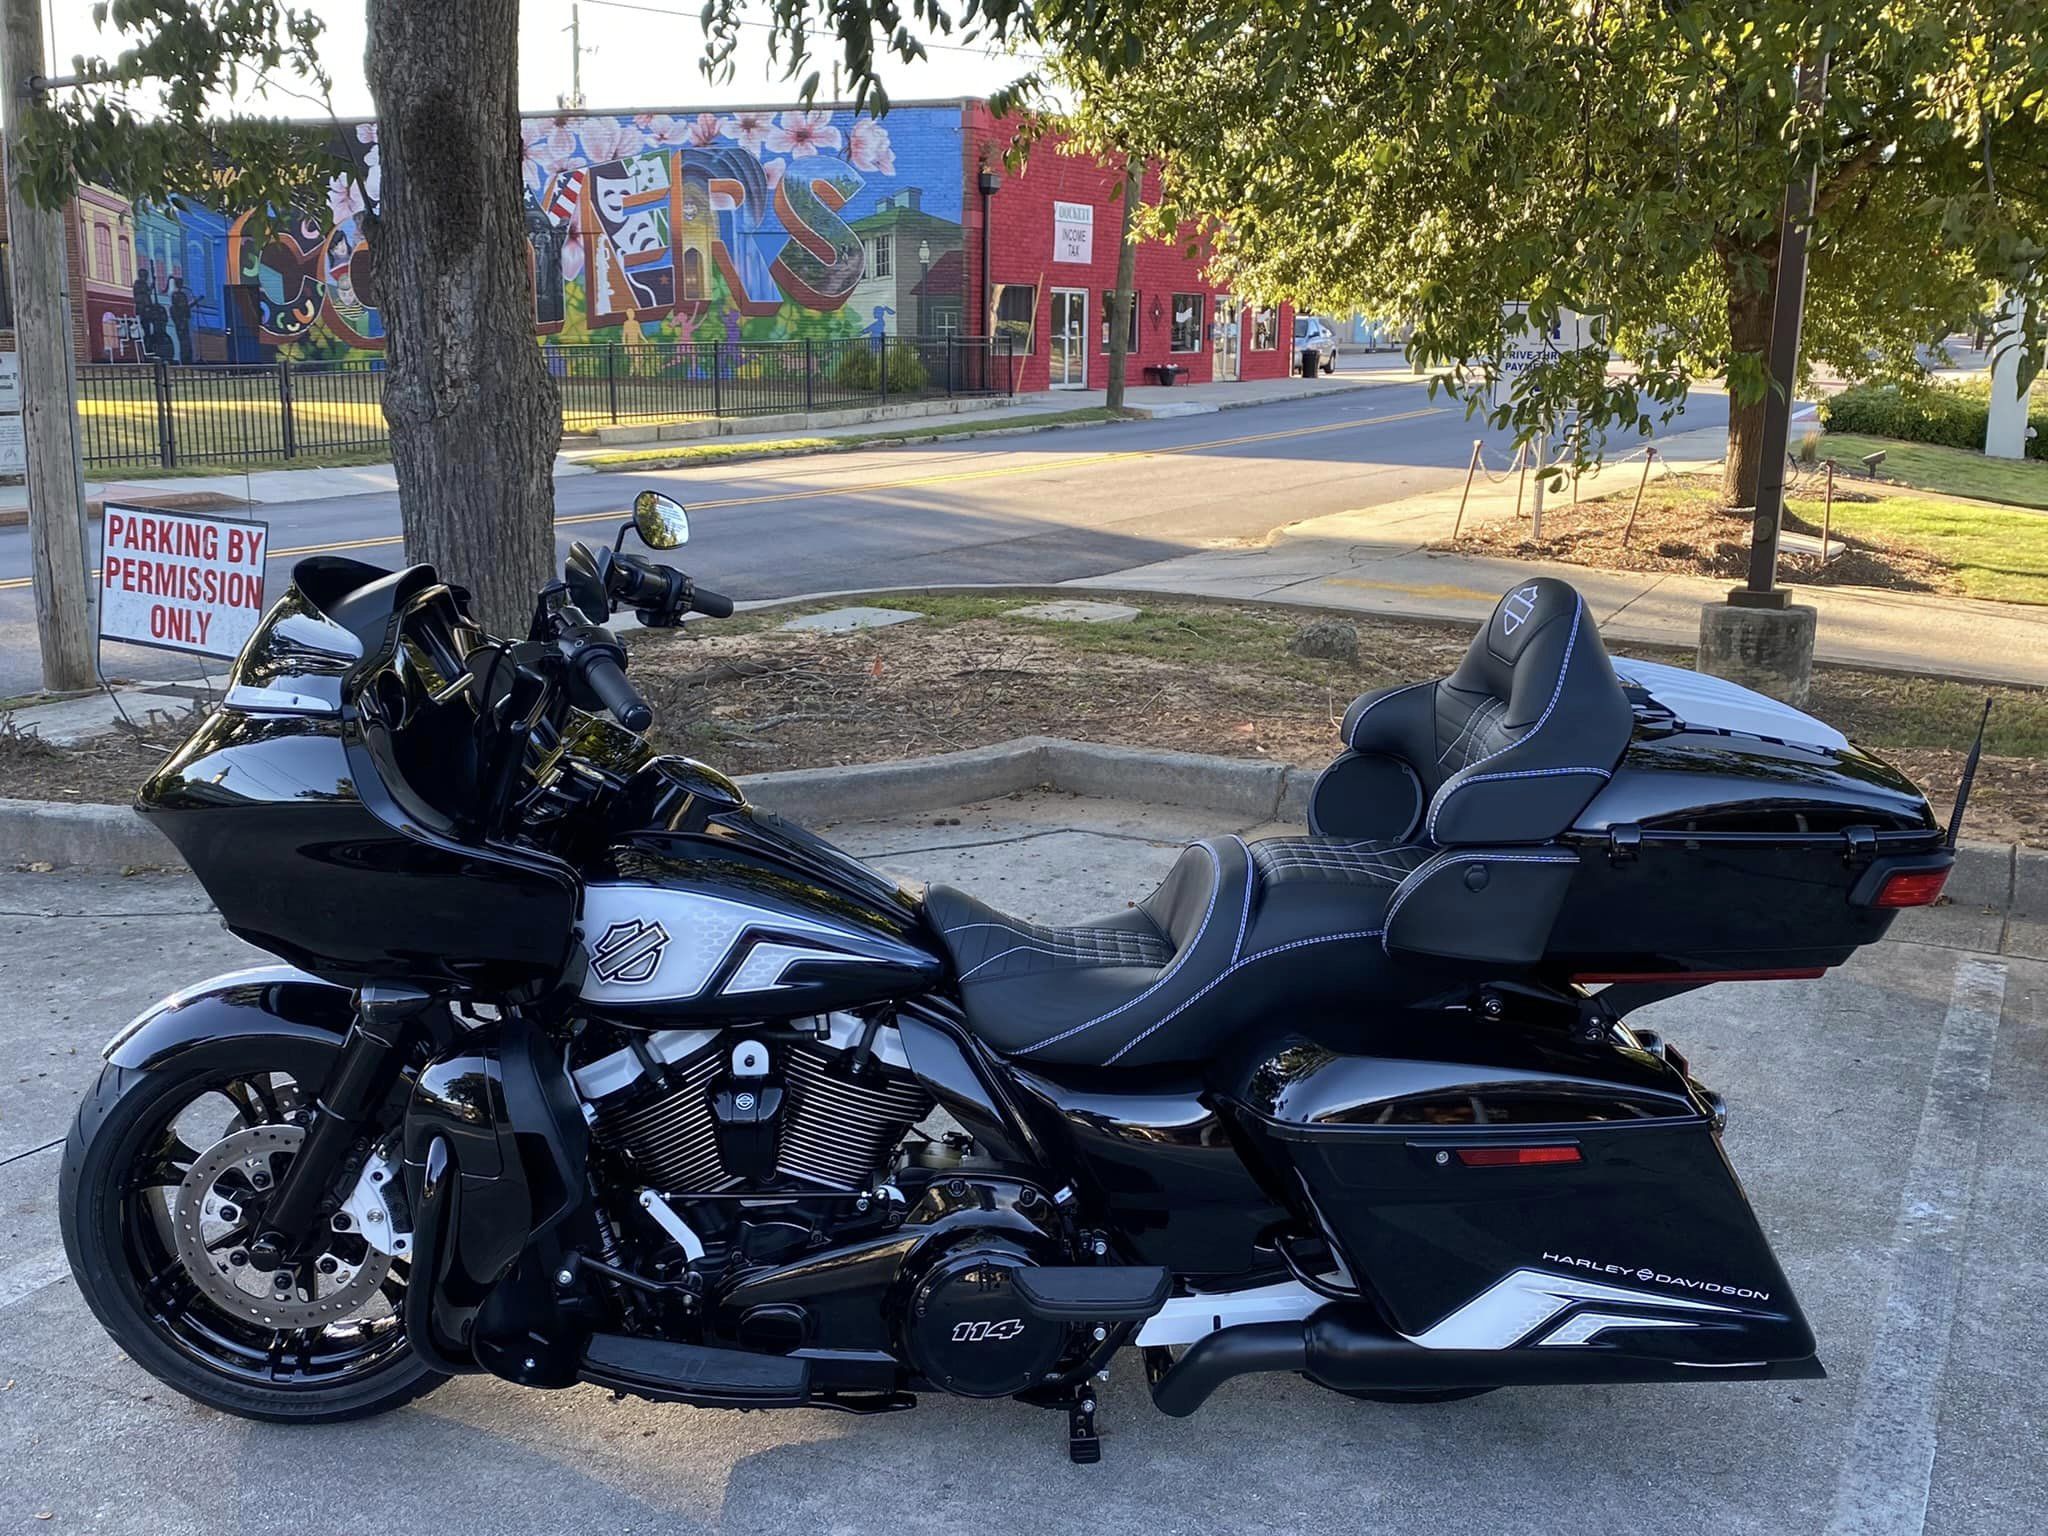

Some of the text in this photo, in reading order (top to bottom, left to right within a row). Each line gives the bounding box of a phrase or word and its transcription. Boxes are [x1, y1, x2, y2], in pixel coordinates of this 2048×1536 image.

[1062, 228, 1087, 242] INCOME
[1068, 244, 1080, 257] TAX
[108, 514, 263, 566] PARKING BY
[105, 556, 262, 610] PERMISSION
[151, 604, 212, 645] ONLY
[1543, 1251, 1770, 1301] HARLEY DAVIDSON
[952, 1319, 1024, 1341] 114
